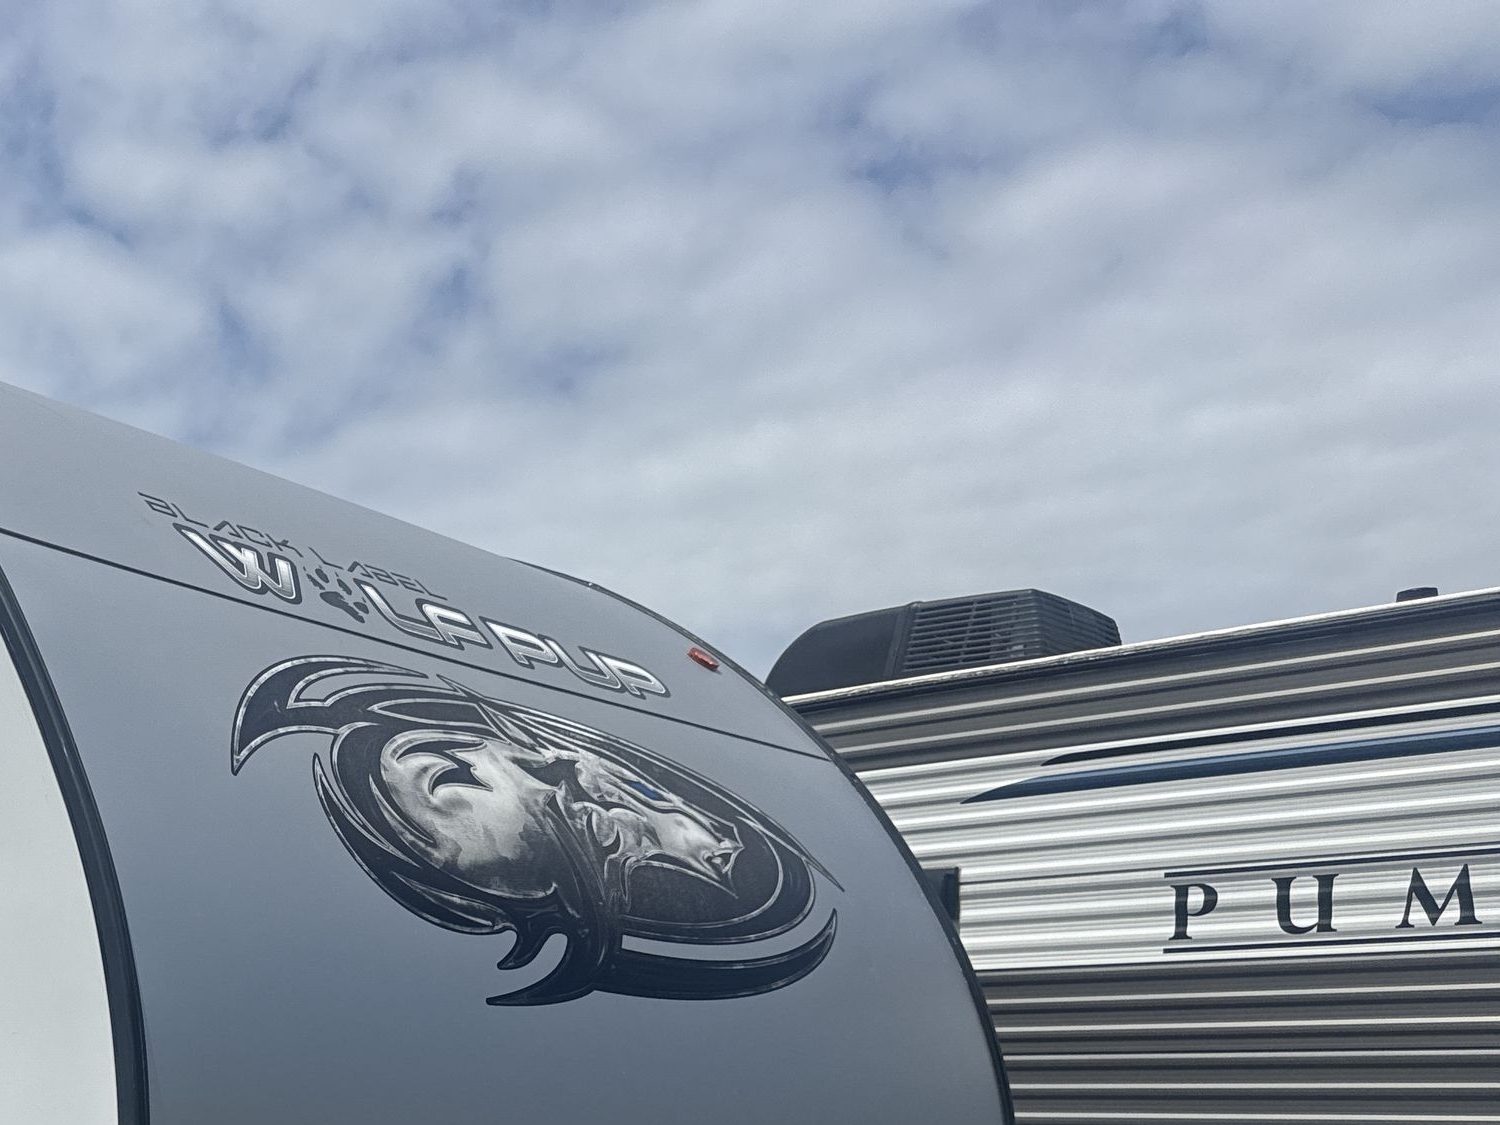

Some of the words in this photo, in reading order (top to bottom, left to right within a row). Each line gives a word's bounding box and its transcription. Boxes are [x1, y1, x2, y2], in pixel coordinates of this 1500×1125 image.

[137, 491, 304, 558] BLACK
[307, 545, 449, 601] LABEL
[478, 615, 671, 700] PUP
[1168, 863, 1483, 941] PUM
